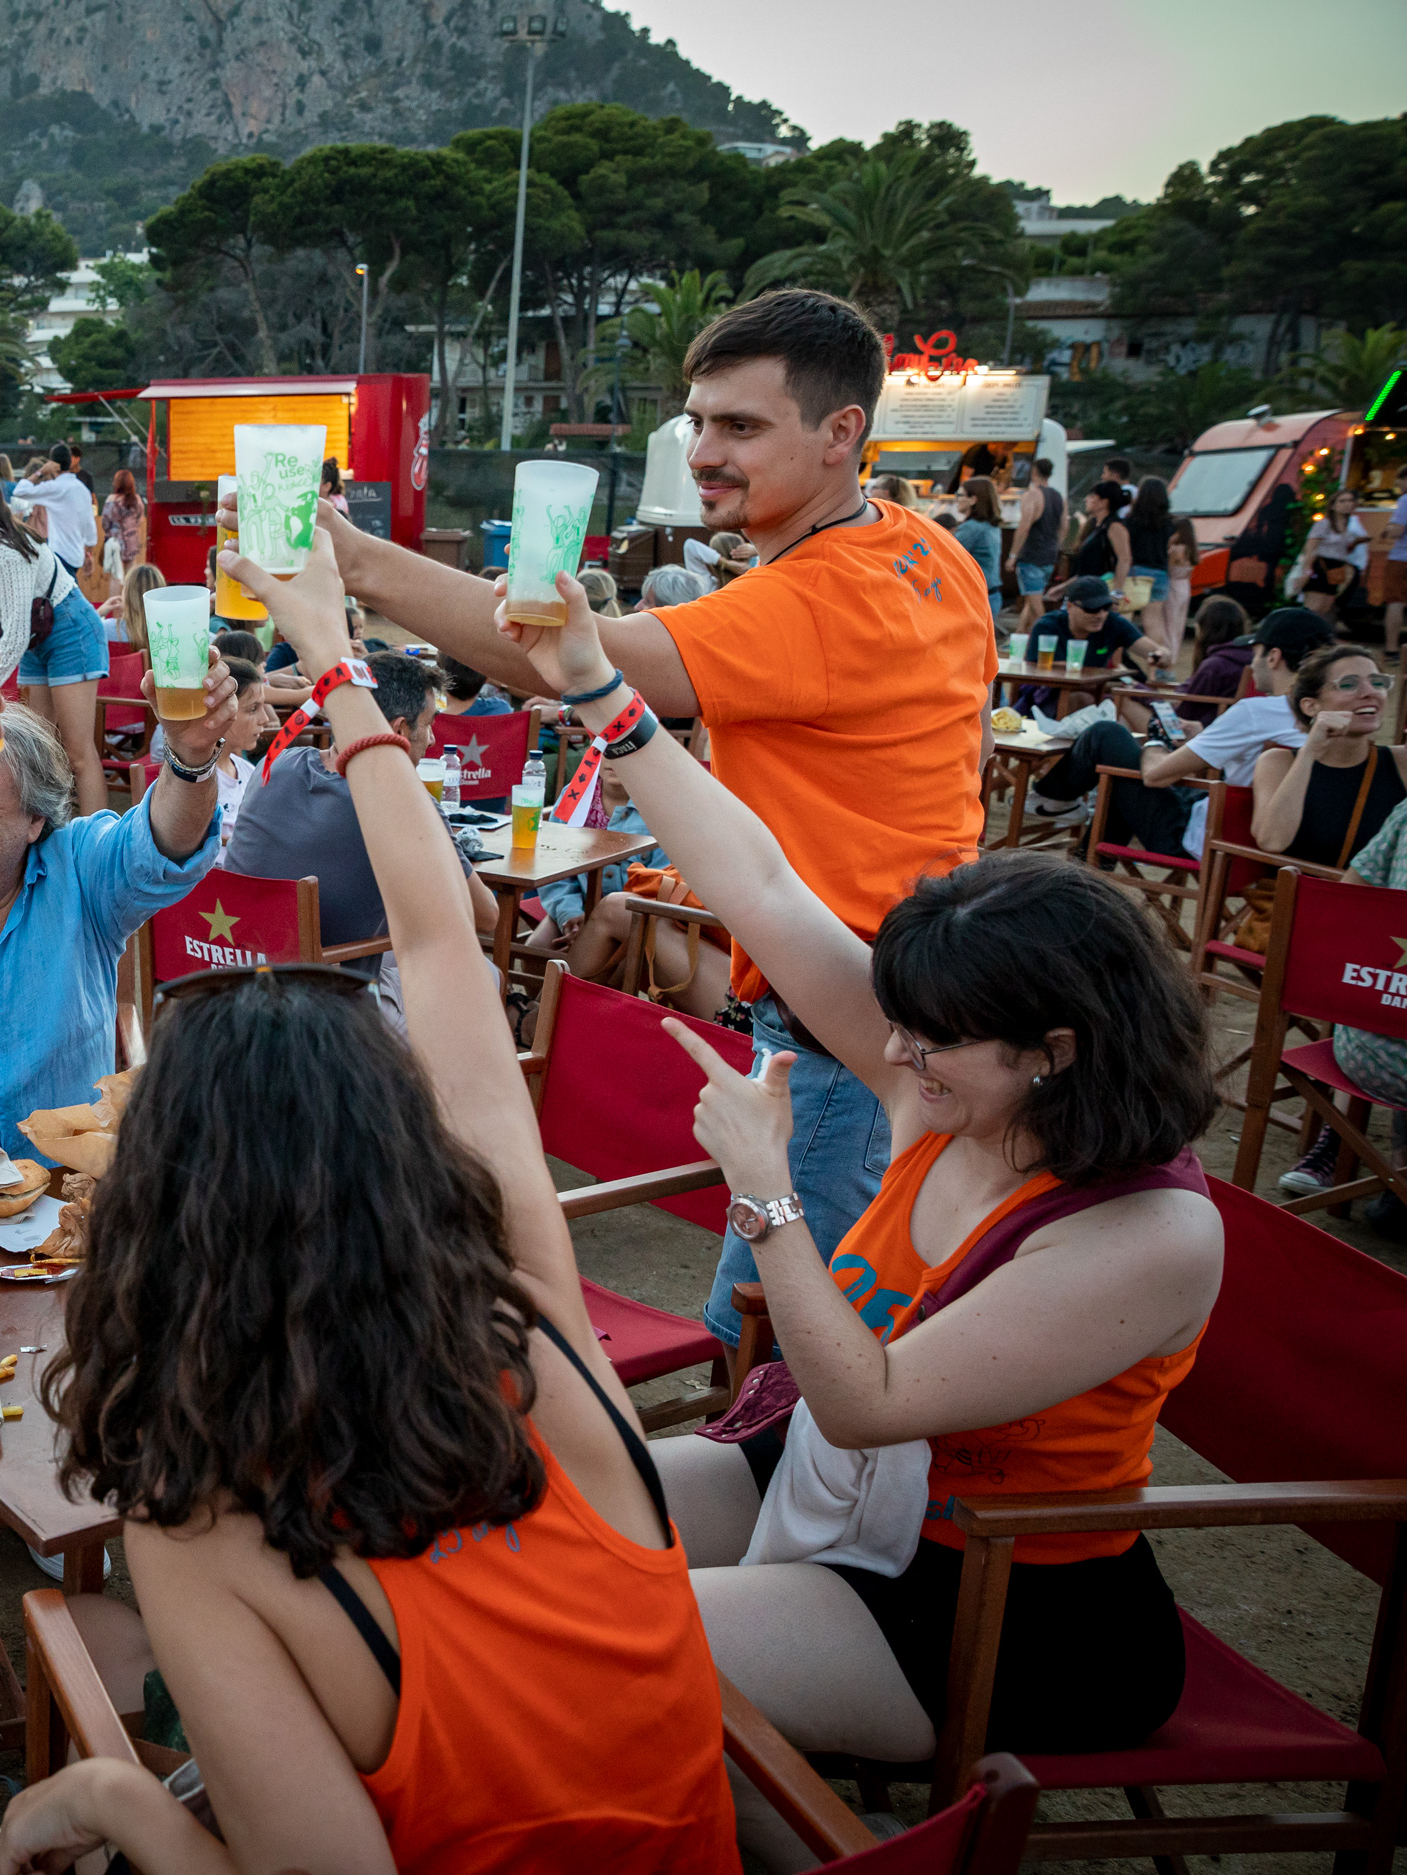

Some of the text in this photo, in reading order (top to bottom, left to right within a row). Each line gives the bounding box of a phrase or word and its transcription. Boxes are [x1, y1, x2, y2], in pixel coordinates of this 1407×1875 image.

[274, 452, 298, 468] Re
[279, 466, 305, 479] use
[460, 766, 492, 780] trella
[184, 935, 267, 967] ESTRELLA
[1342, 962, 1407, 996] ESTR
